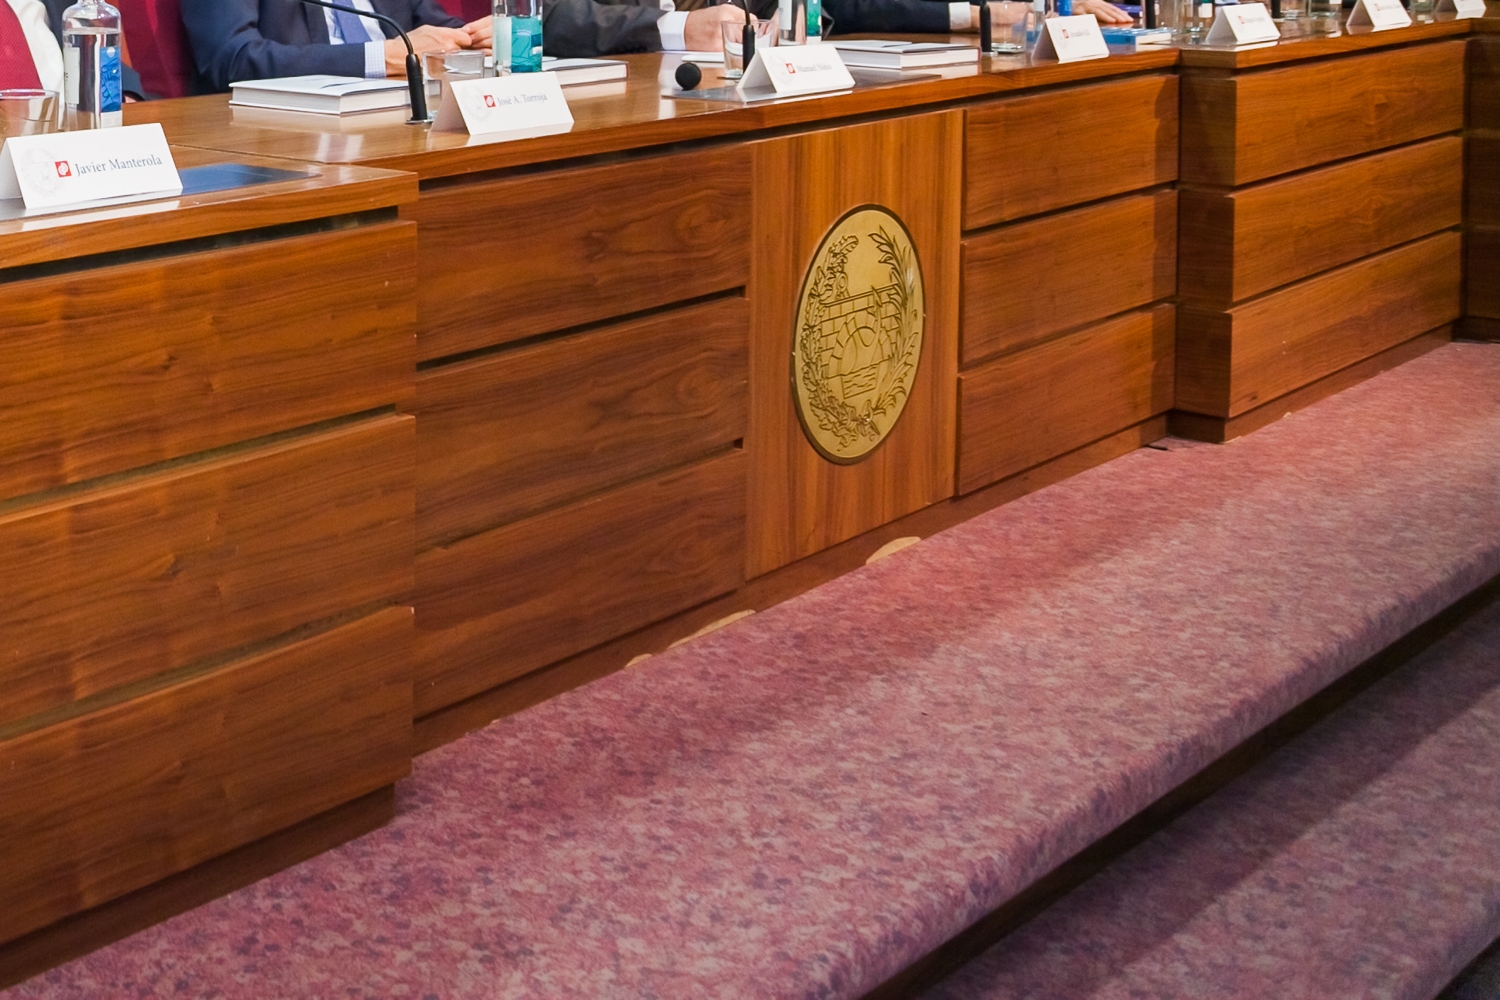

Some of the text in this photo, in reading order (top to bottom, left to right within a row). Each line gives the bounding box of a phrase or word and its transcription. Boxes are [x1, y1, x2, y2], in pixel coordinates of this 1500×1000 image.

[520, 91, 548, 105] Torroja
[74, 153, 163, 177] Javier Manterola
